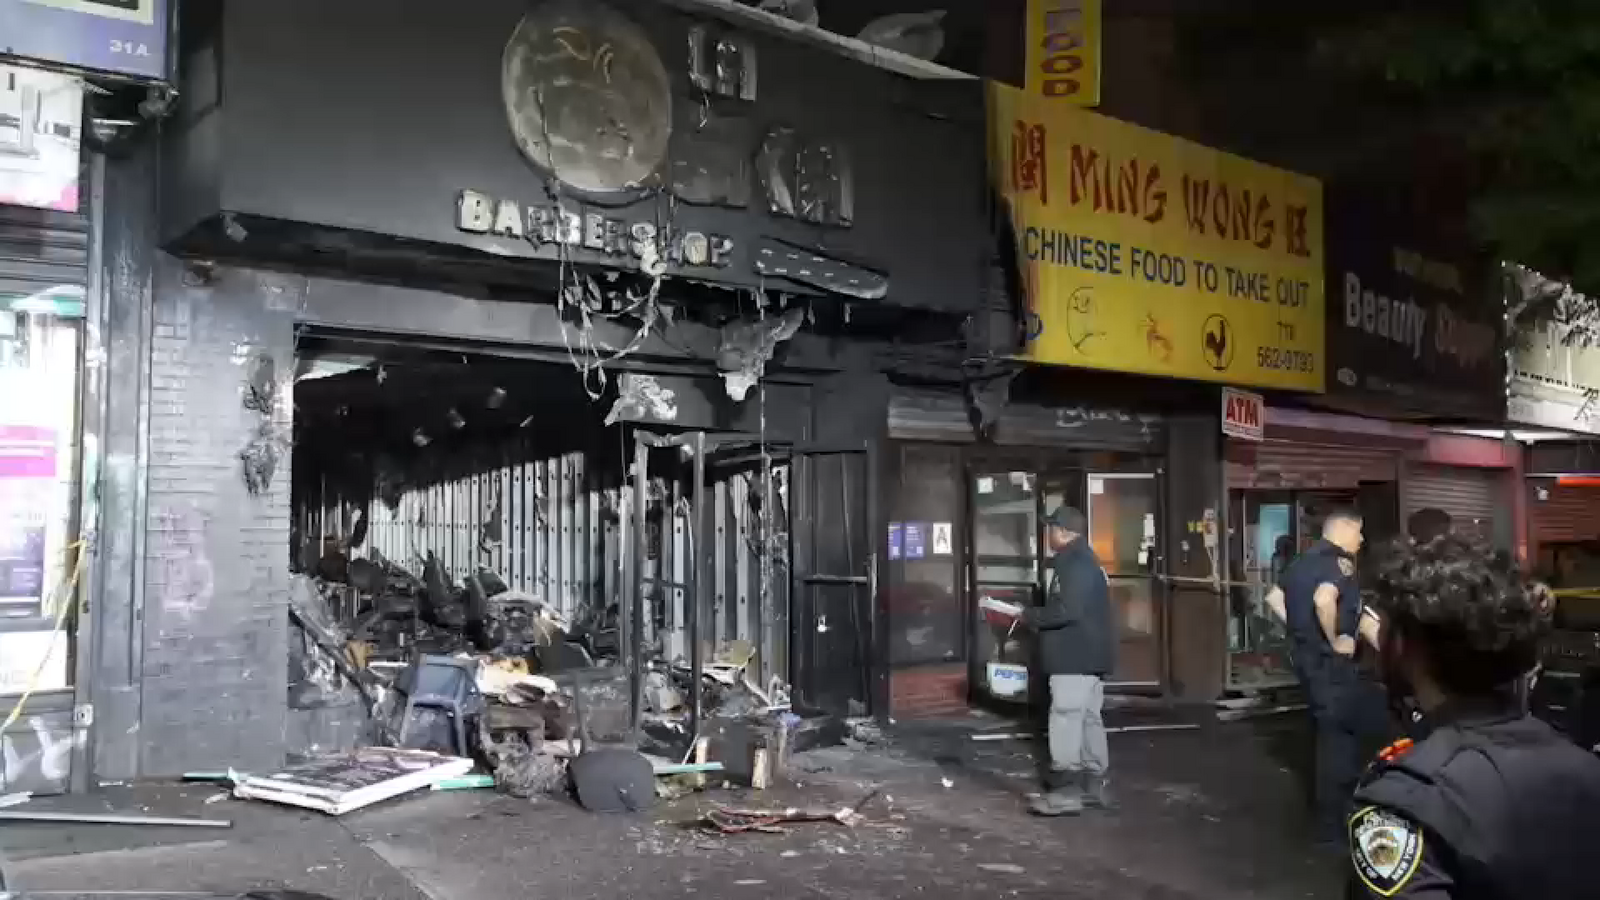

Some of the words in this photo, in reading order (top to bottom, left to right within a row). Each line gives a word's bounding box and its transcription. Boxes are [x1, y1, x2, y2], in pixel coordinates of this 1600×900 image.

[1069, 143, 1167, 224] MING
[1182, 173, 1275, 250] WONG
[1024, 225, 1122, 275] CHINESE
[1131, 246, 1186, 287] FOOD
[1193, 259, 1218, 292] TO
[1225, 267, 1270, 302] TAKE
[1276, 277, 1309, 307] OUT
[1345, 271, 1427, 361] Beauty
[1226, 397, 1259, 428] ATM
[936, 526, 949, 551] A
